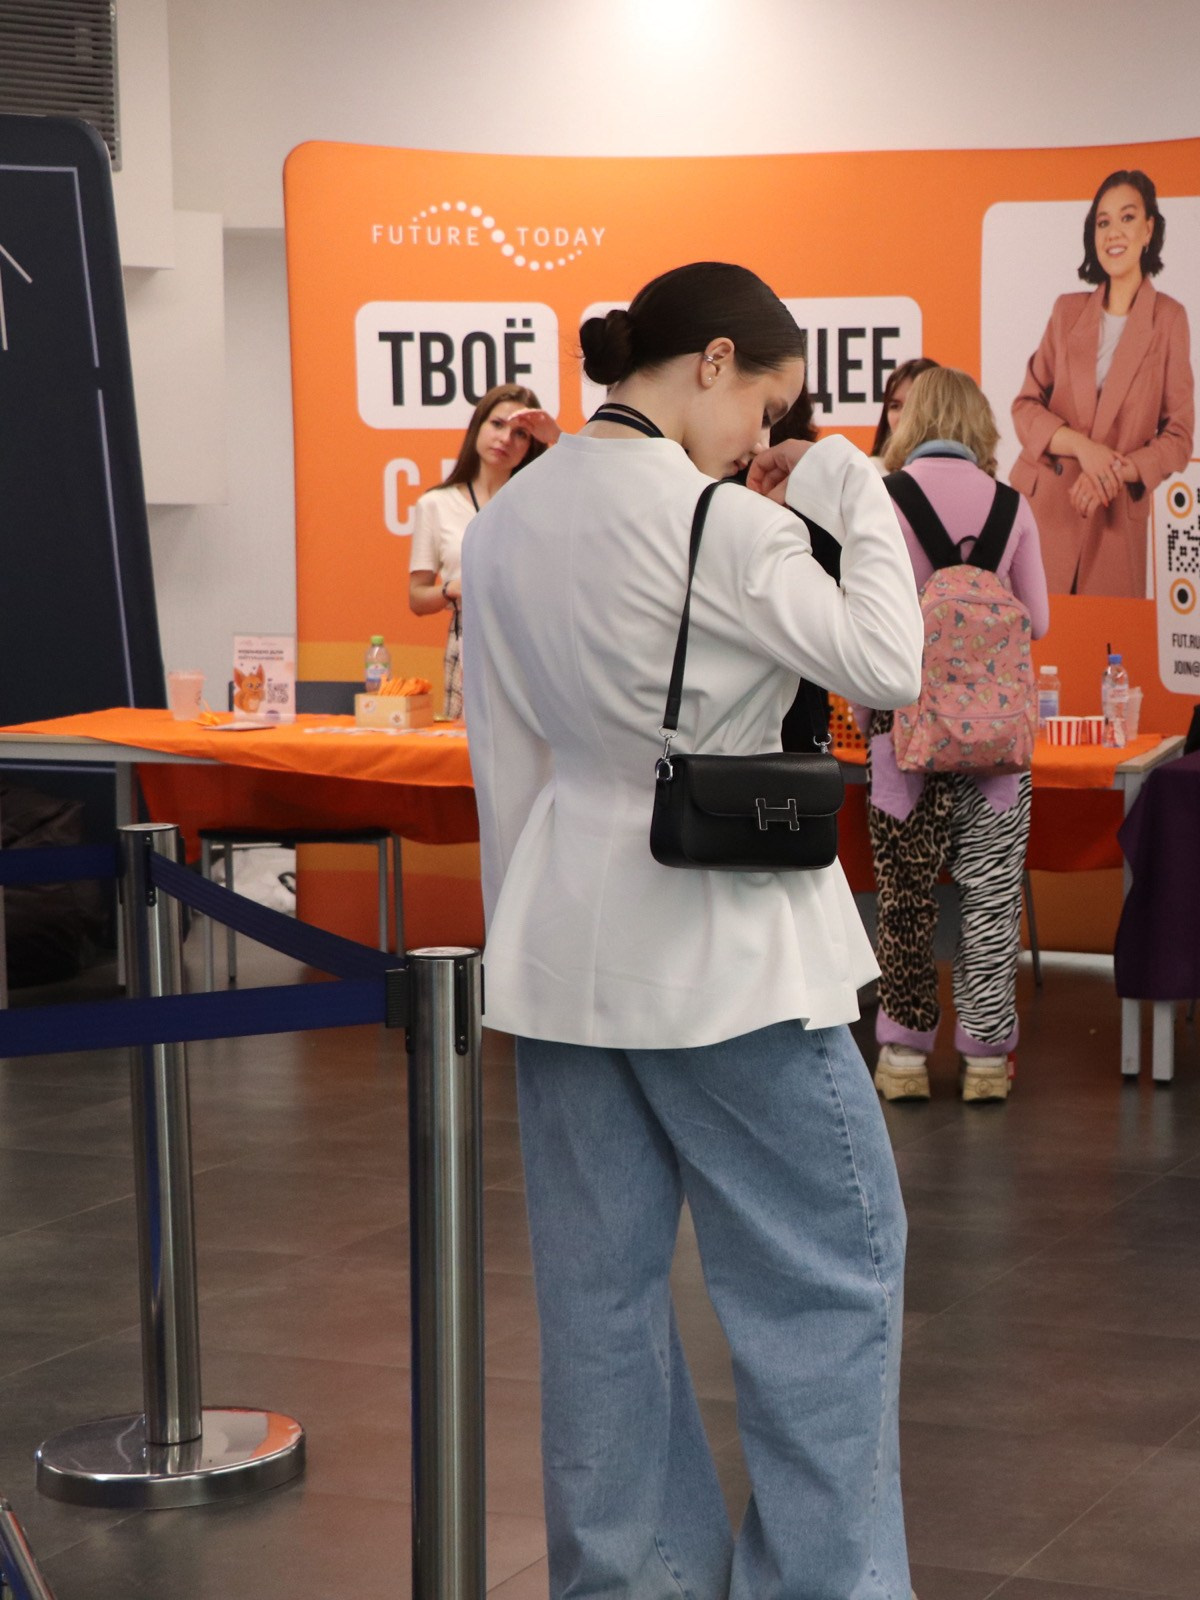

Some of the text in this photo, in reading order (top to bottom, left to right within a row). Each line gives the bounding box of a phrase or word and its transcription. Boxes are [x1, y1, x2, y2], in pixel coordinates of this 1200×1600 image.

[372, 224, 606, 247] FUTURE TODAY
[378, 318, 536, 407] ТВОЁ
[1171, 633, 1200, 649] FUT.RU
